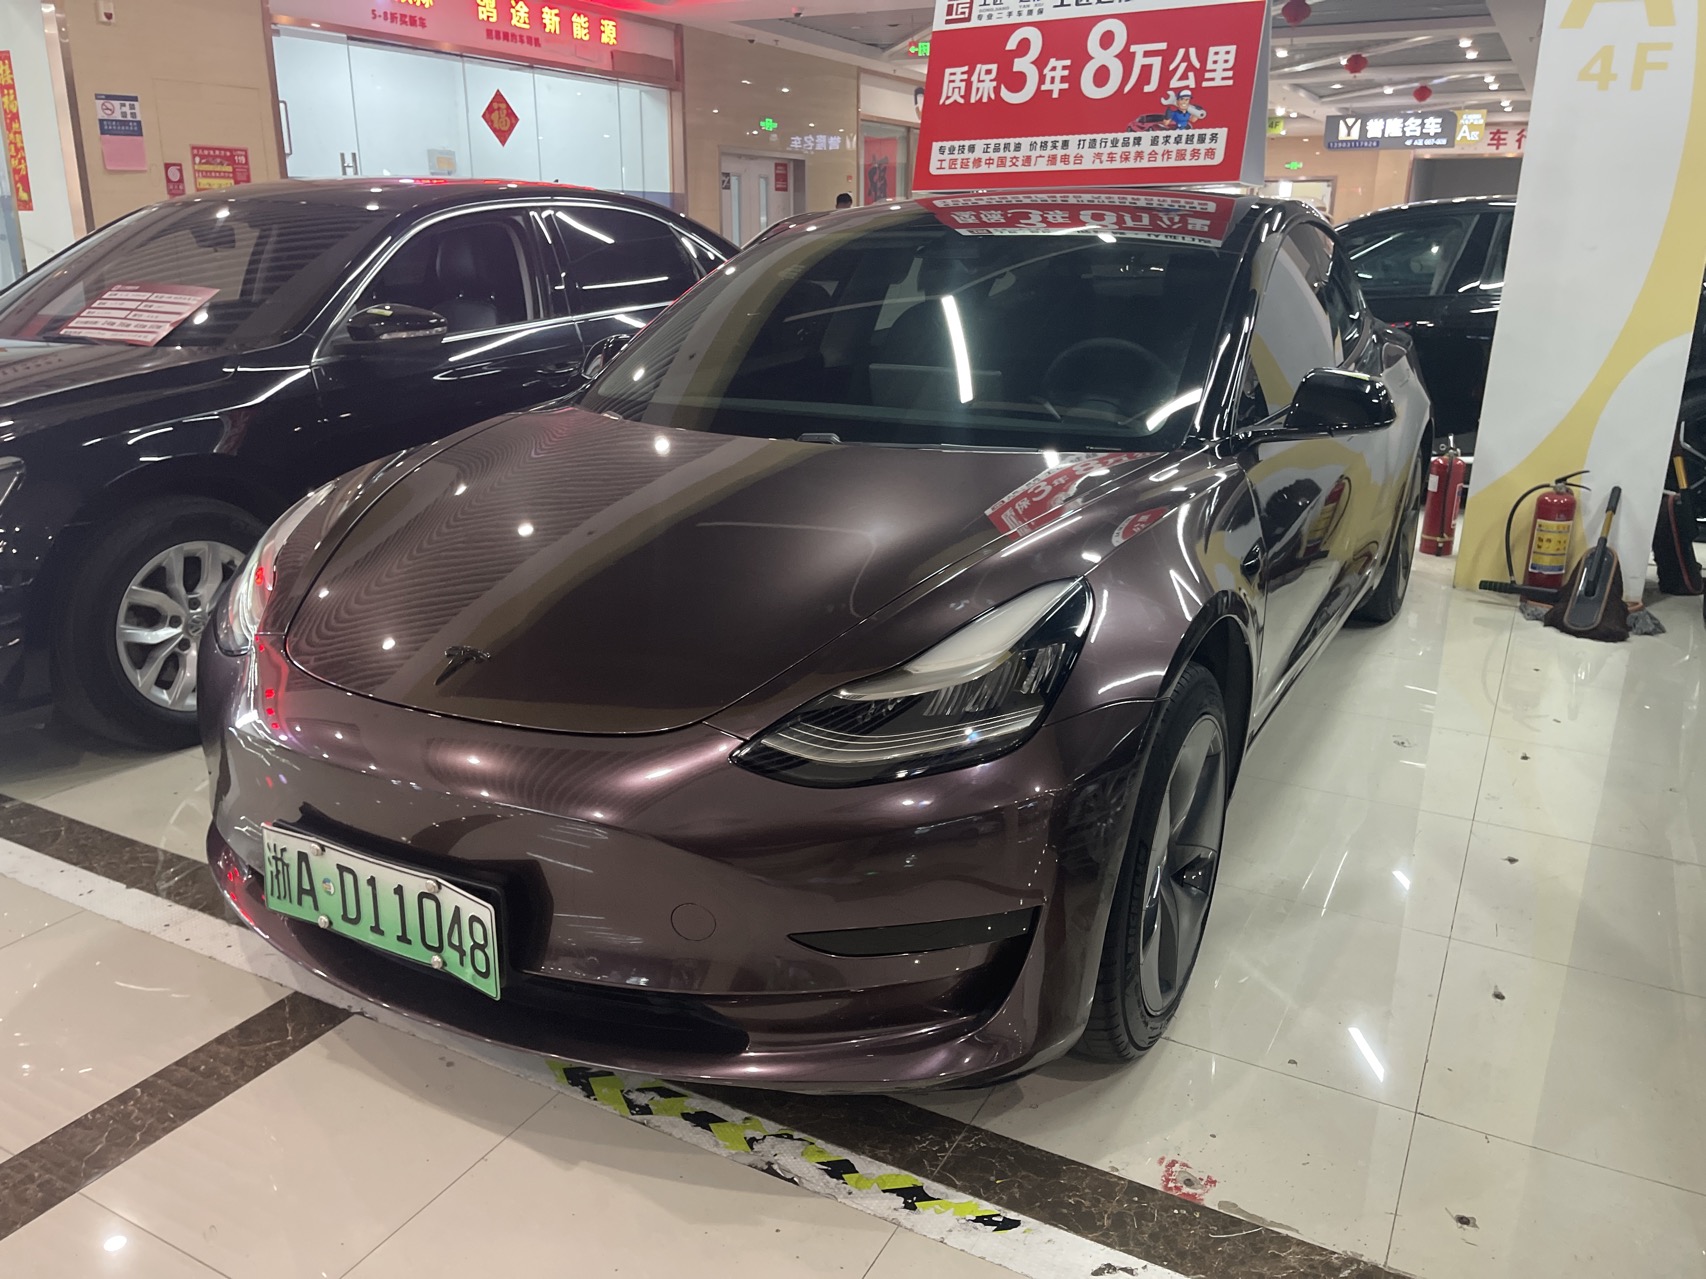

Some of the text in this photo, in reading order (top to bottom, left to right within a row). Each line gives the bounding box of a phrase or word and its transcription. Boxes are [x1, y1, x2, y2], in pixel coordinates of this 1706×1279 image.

[977, 8, 1044, 20] 专业二手车质保
[1577, 42, 1674, 91] 4F
[1366, 116, 1443, 138] 誉隆名车
[938, 133, 1219, 155] 专业技师 正品机油 价格实惠 打造行业品牌 追求卓越服务
[234, 155, 246, 164] 119
[936, 147, 1217, 170] 工匠延修中国交通广播电台 汽车保养合作服务商
